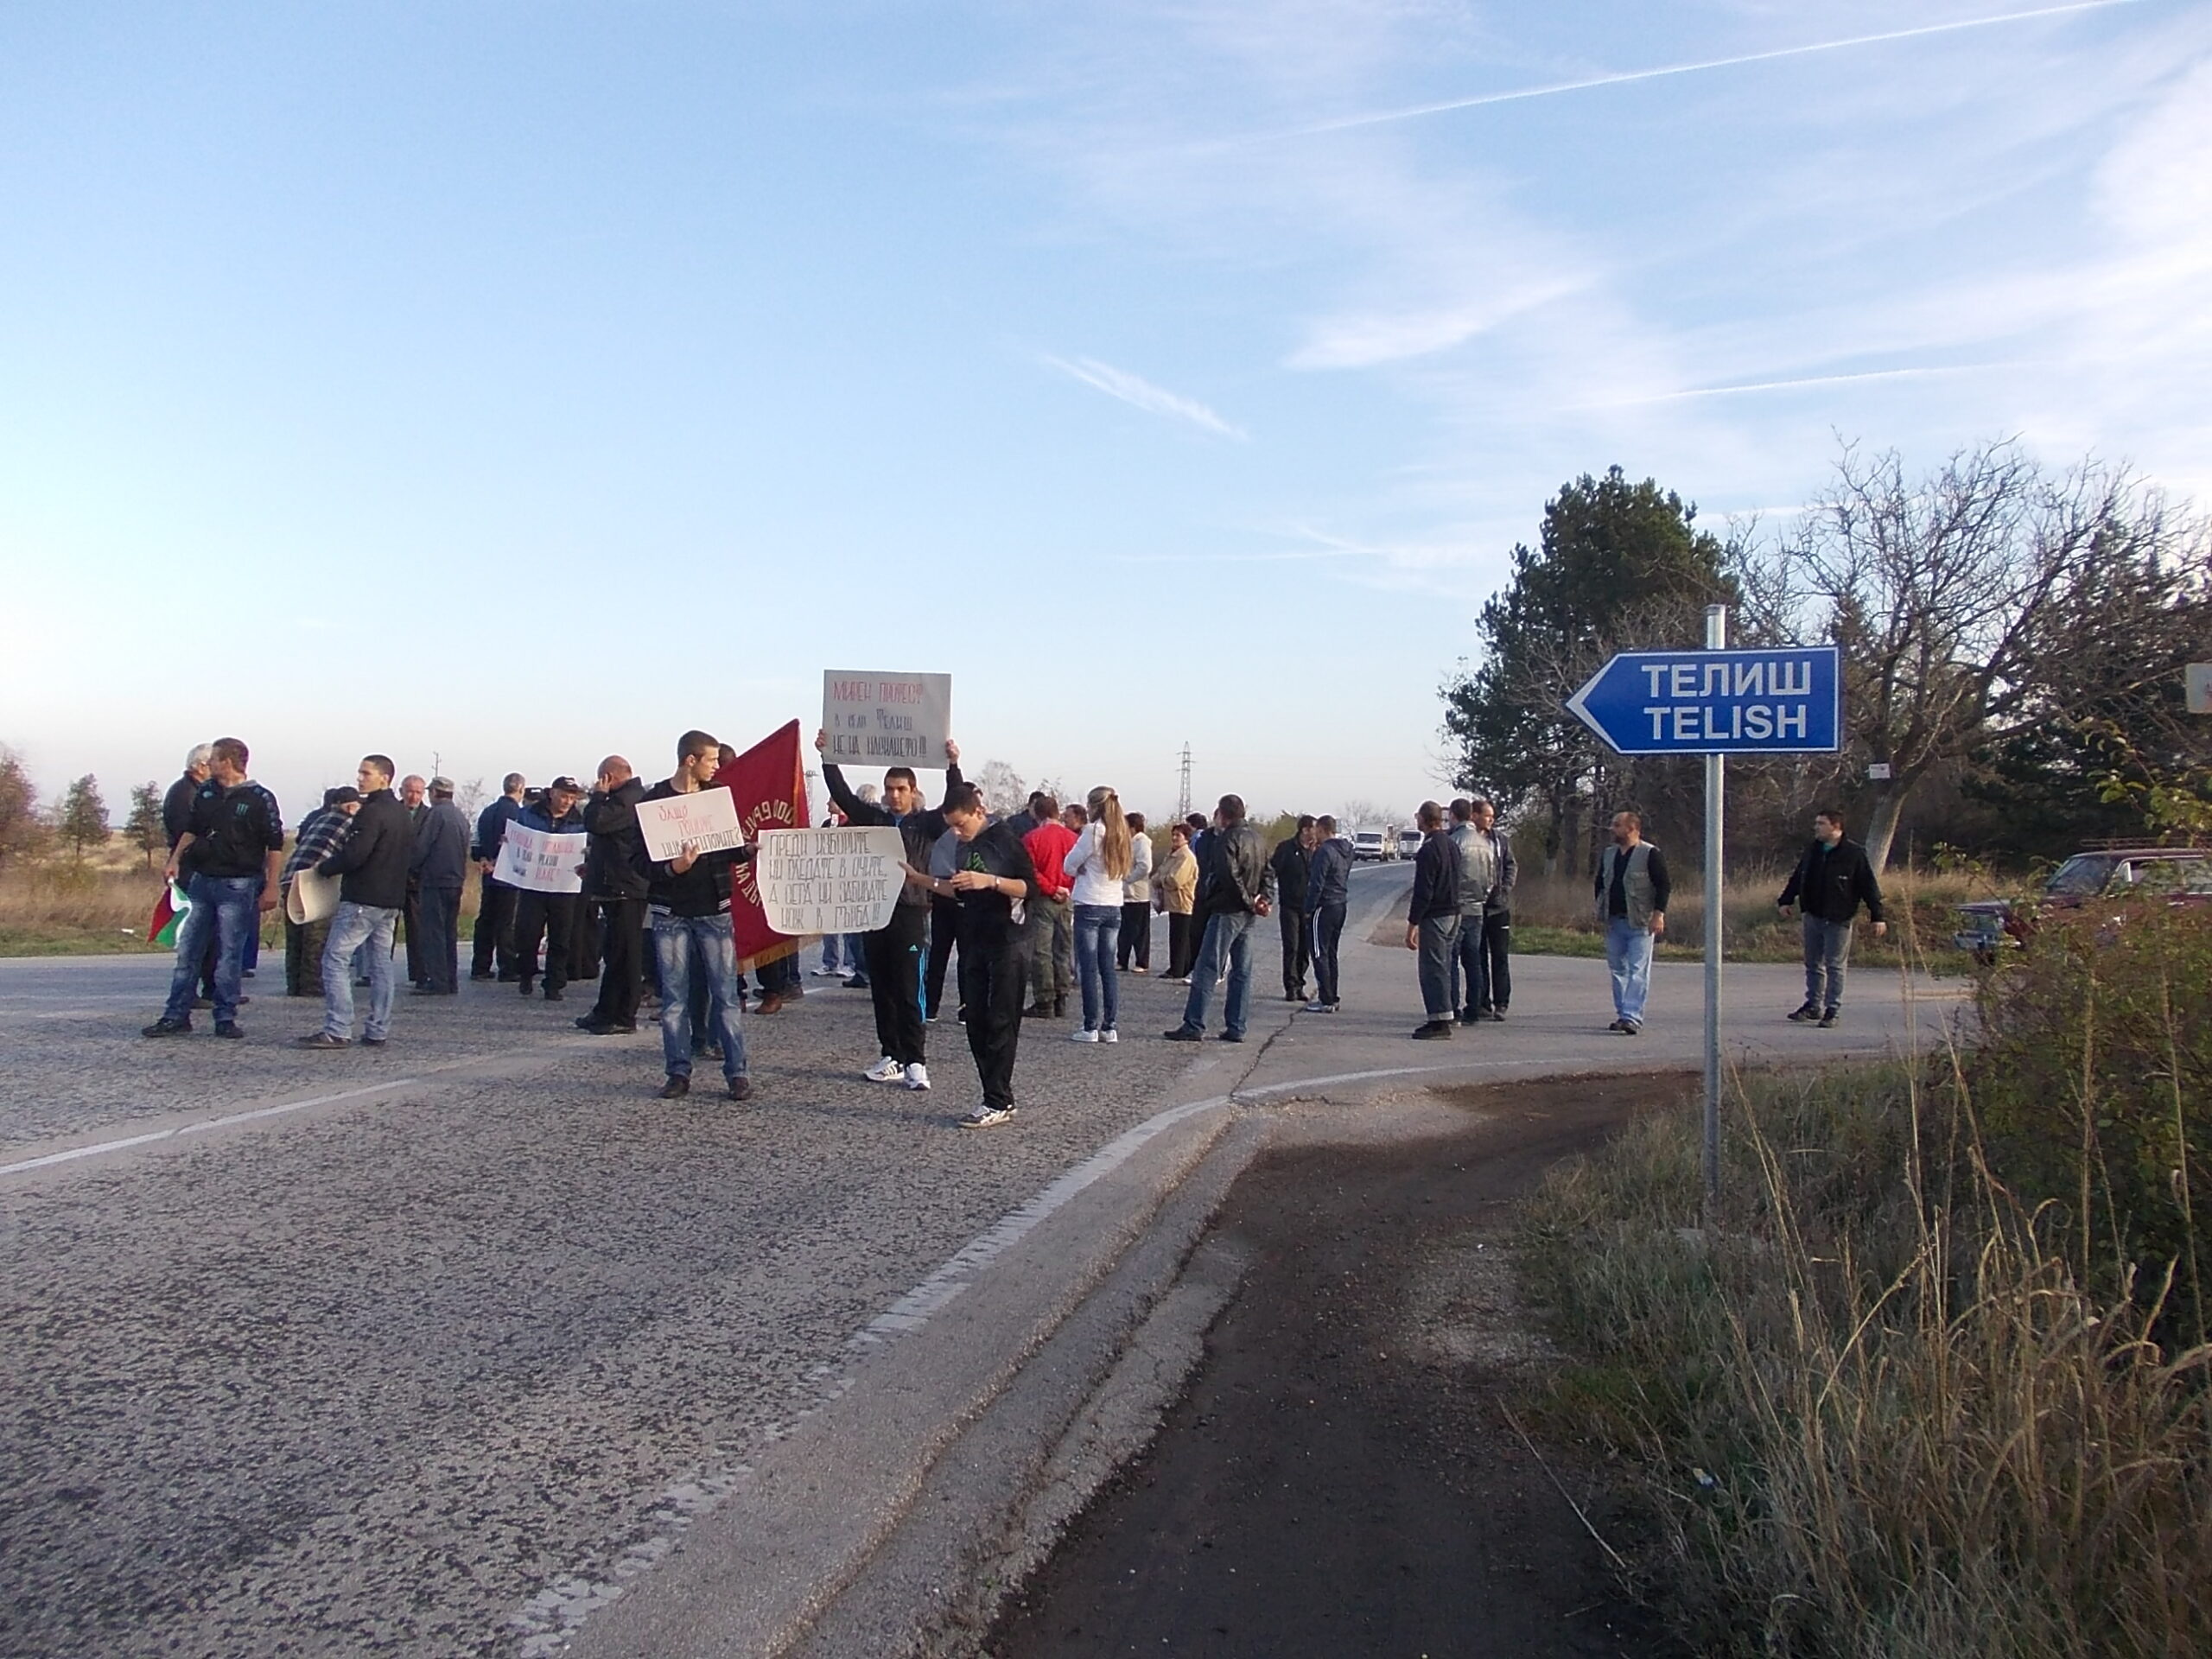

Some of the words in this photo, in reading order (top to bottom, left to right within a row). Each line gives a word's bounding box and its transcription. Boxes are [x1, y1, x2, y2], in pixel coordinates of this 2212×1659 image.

[834, 681, 872, 702] МИРЕН
[1641, 660, 1812, 698] ТЕЛИШ
[1643, 704, 1807, 741] TELISH
[833, 734, 844, 755] НЕ
[849, 735, 861, 755] НА
[769, 834, 808, 857] ПРЕДИ
[816, 832, 872, 855] ИЗБОРИТЕ
[769, 859, 783, 880] НИ
[788, 857, 835, 882] ГЛЕДАТЕ
[839, 859, 846, 878] В
[769, 883, 779, 904] А
[785, 882, 813, 905] СЕГА
[818, 882, 832, 904] НИ
[839, 880, 888, 902] ЗАБИВАТЕ
[781, 907, 804, 930] НОЖ
[817, 907, 823, 929] В
